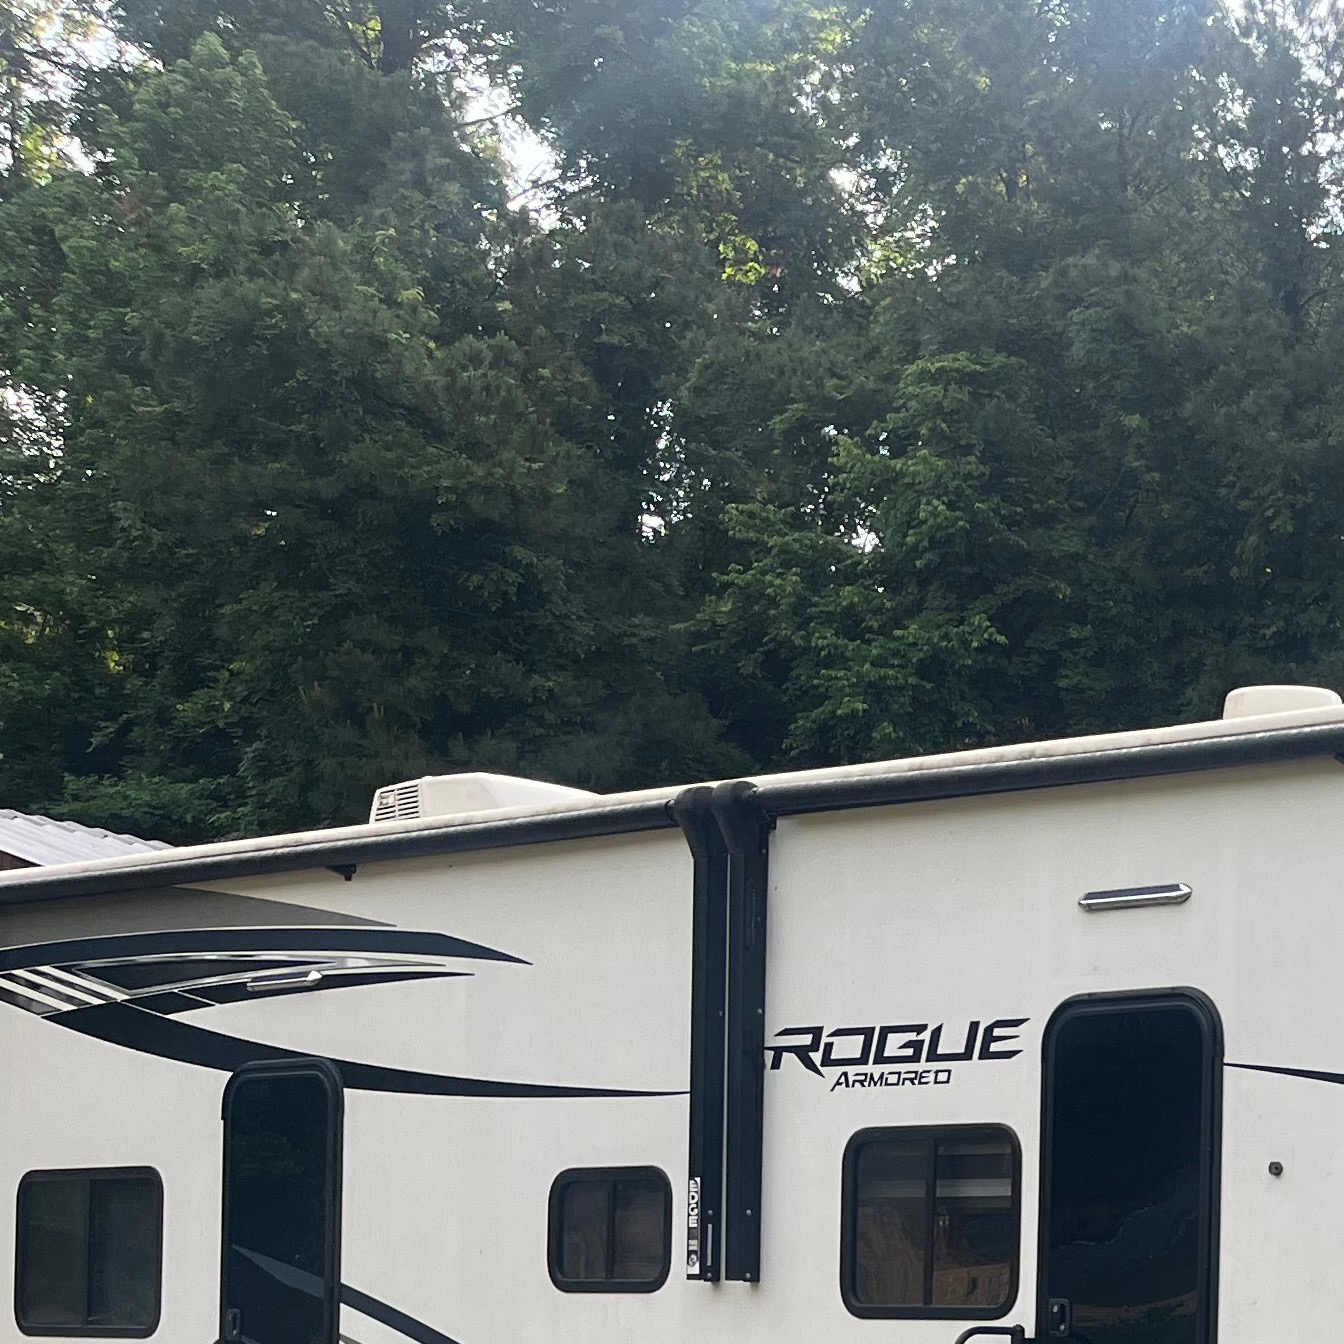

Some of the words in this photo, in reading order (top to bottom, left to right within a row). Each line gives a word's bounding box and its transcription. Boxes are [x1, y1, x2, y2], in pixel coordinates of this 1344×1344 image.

[764, 1017, 1031, 1078] ROGUE
[830, 1068, 952, 1092] ARMORED
[688, 1179, 699, 1228] EDGE
